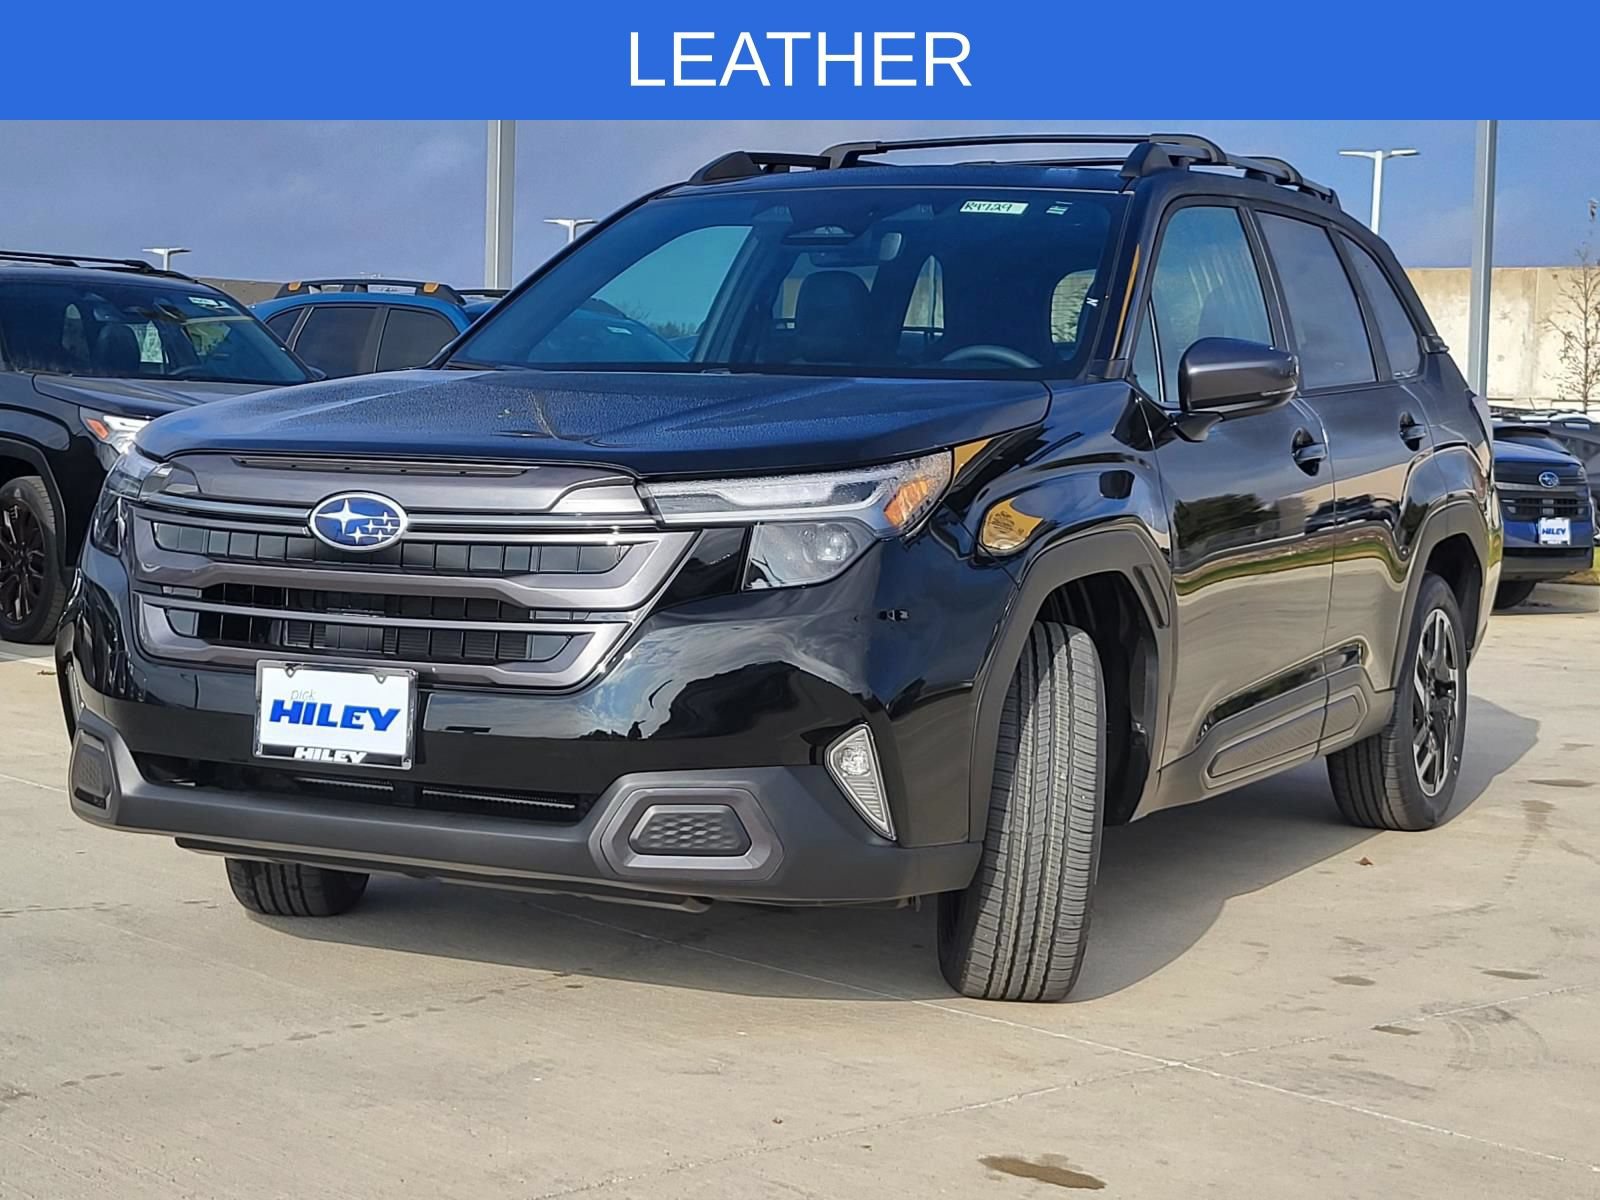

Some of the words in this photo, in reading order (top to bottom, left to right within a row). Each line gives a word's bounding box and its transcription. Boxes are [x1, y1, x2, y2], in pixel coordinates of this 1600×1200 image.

[1542, 527, 1566, 535] HILEY
[269, 699, 401, 731] HILEY
[293, 747, 367, 763] HILEY
